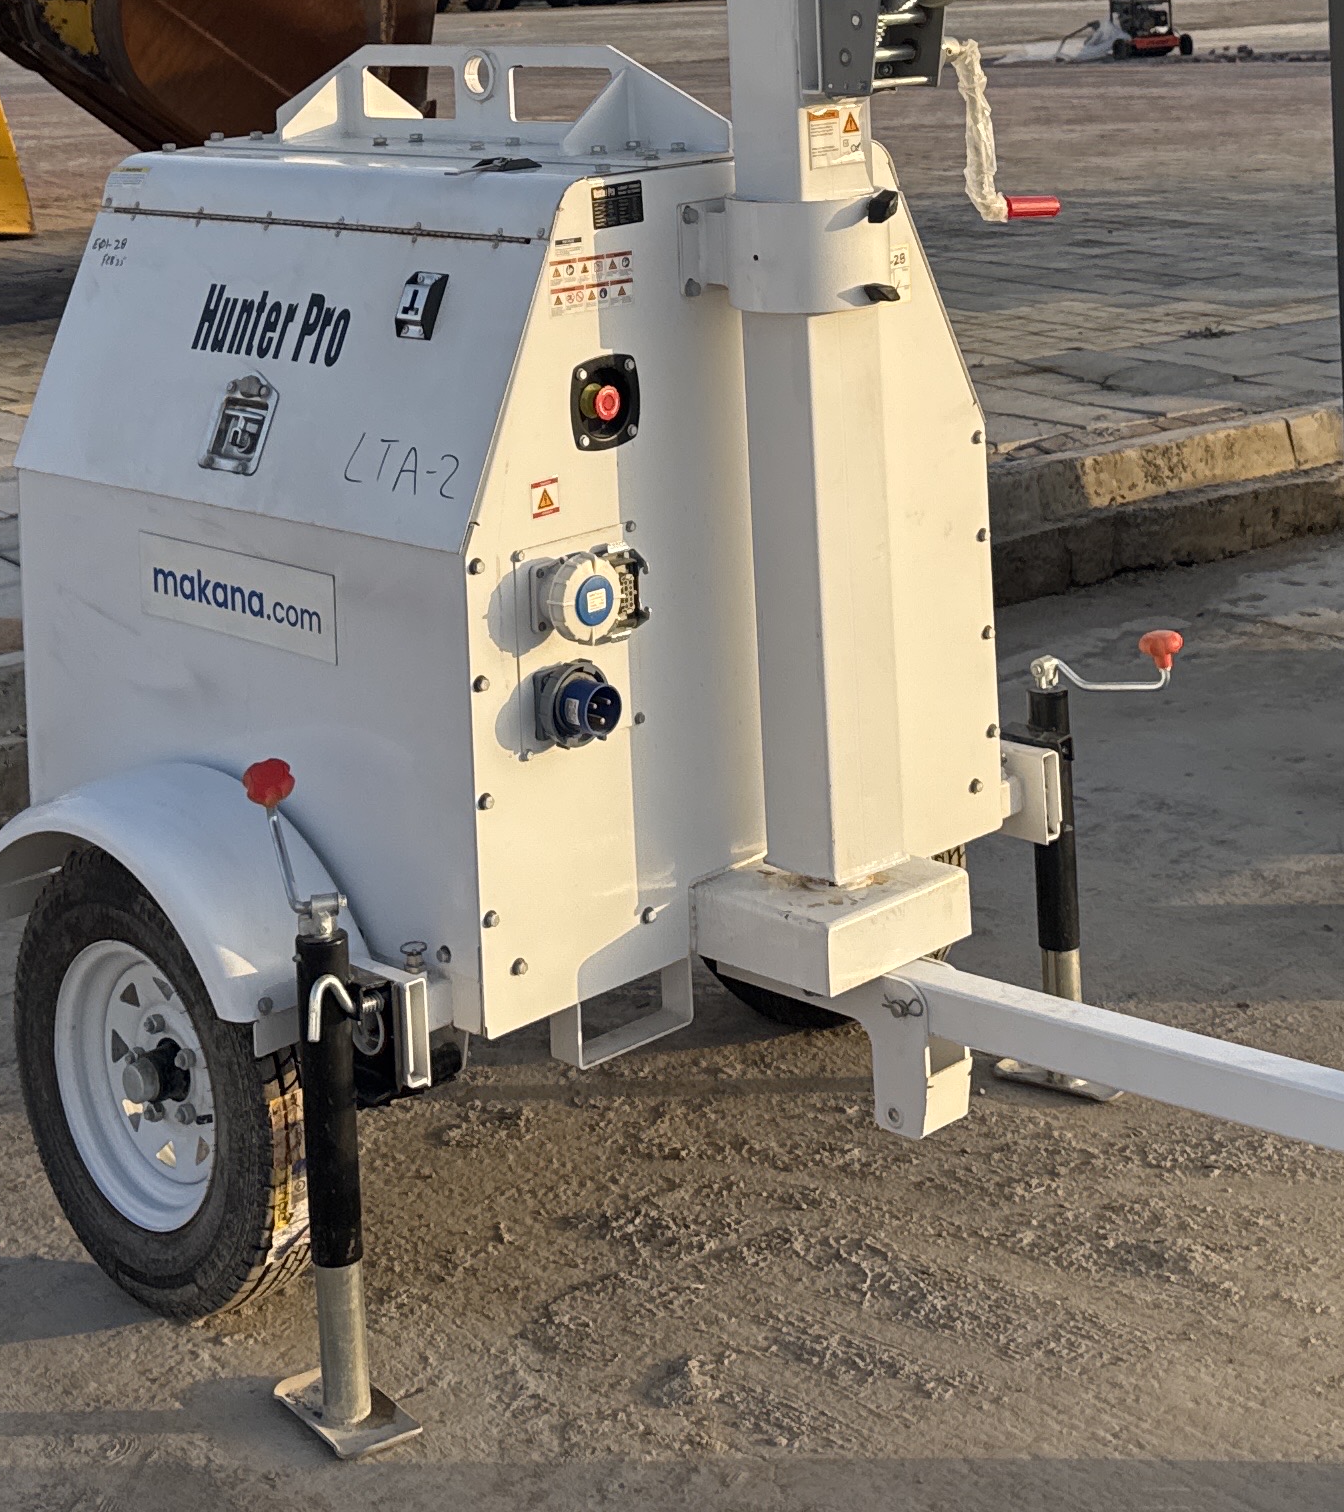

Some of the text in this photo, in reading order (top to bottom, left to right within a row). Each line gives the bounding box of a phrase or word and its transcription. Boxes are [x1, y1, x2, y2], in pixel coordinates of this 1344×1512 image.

[191, 283, 351, 367] Hunter Pro
[344, 432, 460, 500] LTA-2
[153, 566, 322, 634] makana.com
